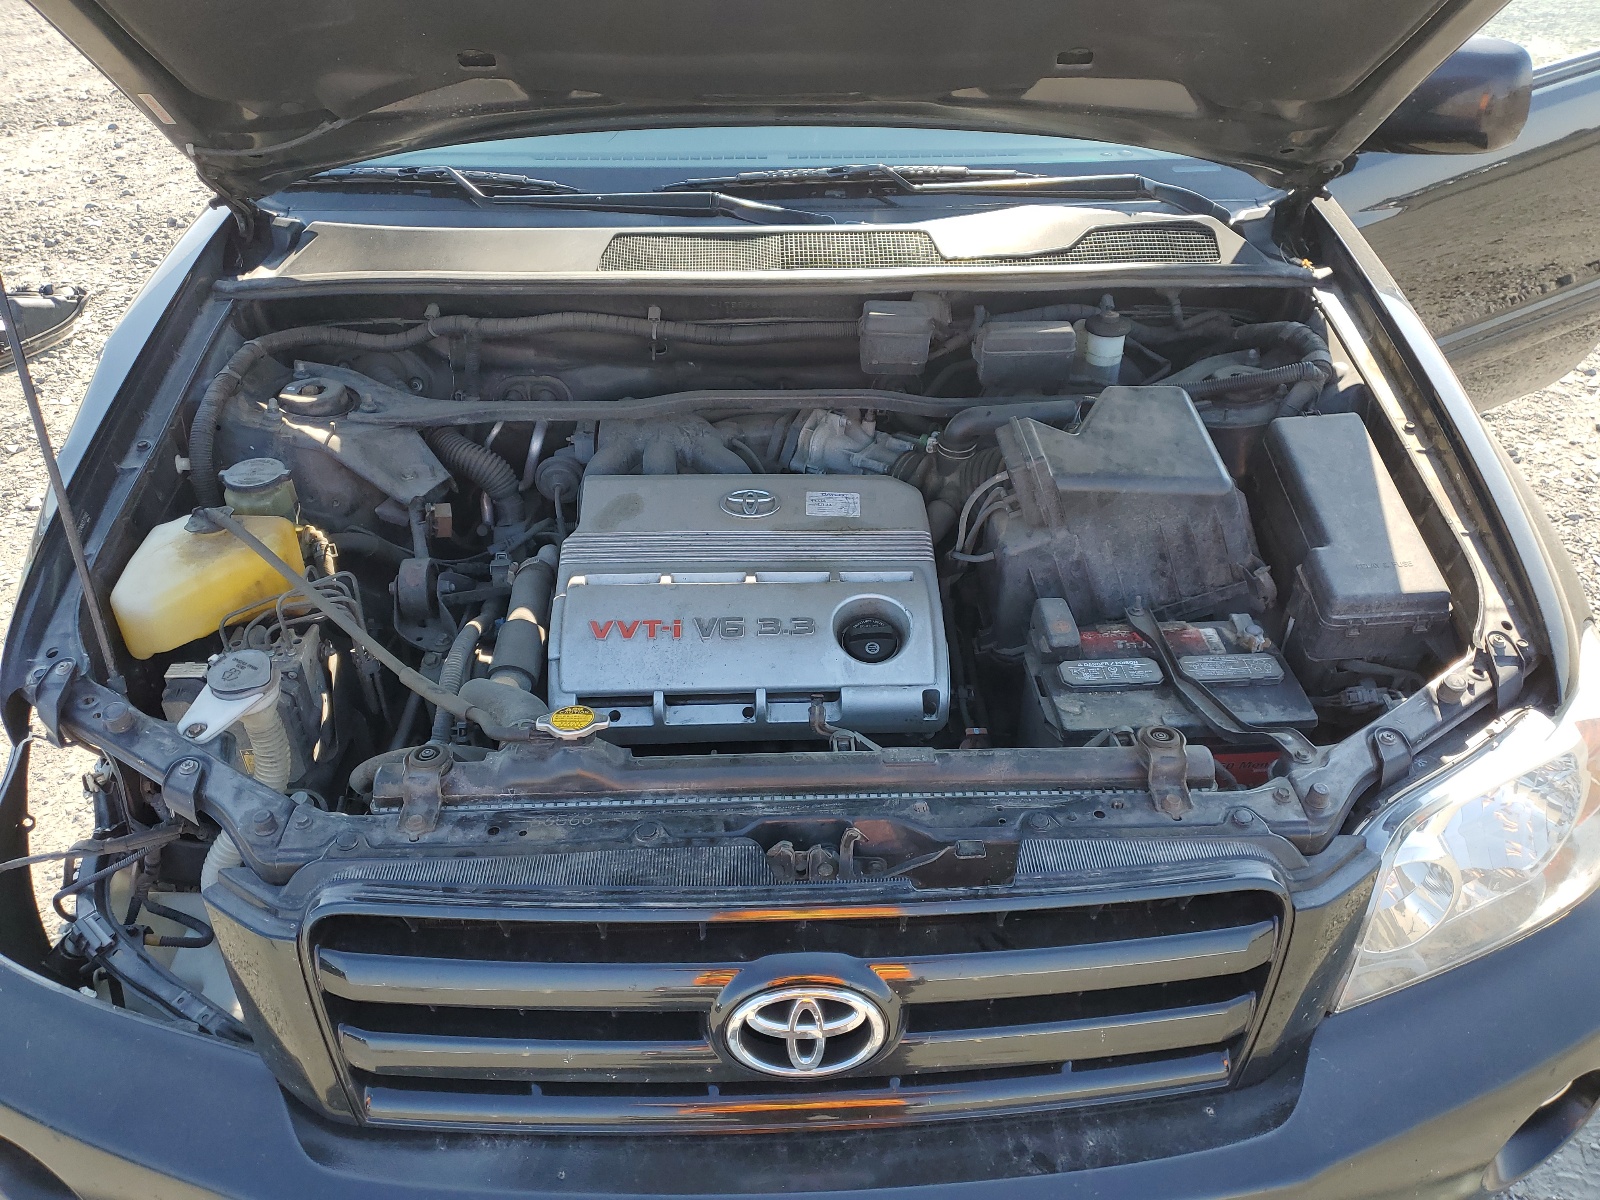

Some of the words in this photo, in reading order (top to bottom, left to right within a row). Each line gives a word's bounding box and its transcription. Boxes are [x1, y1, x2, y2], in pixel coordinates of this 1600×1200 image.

[589, 619, 683, 640] VVT-i
[693, 616, 746, 640] V6
[756, 617, 816, 637] 3.3
